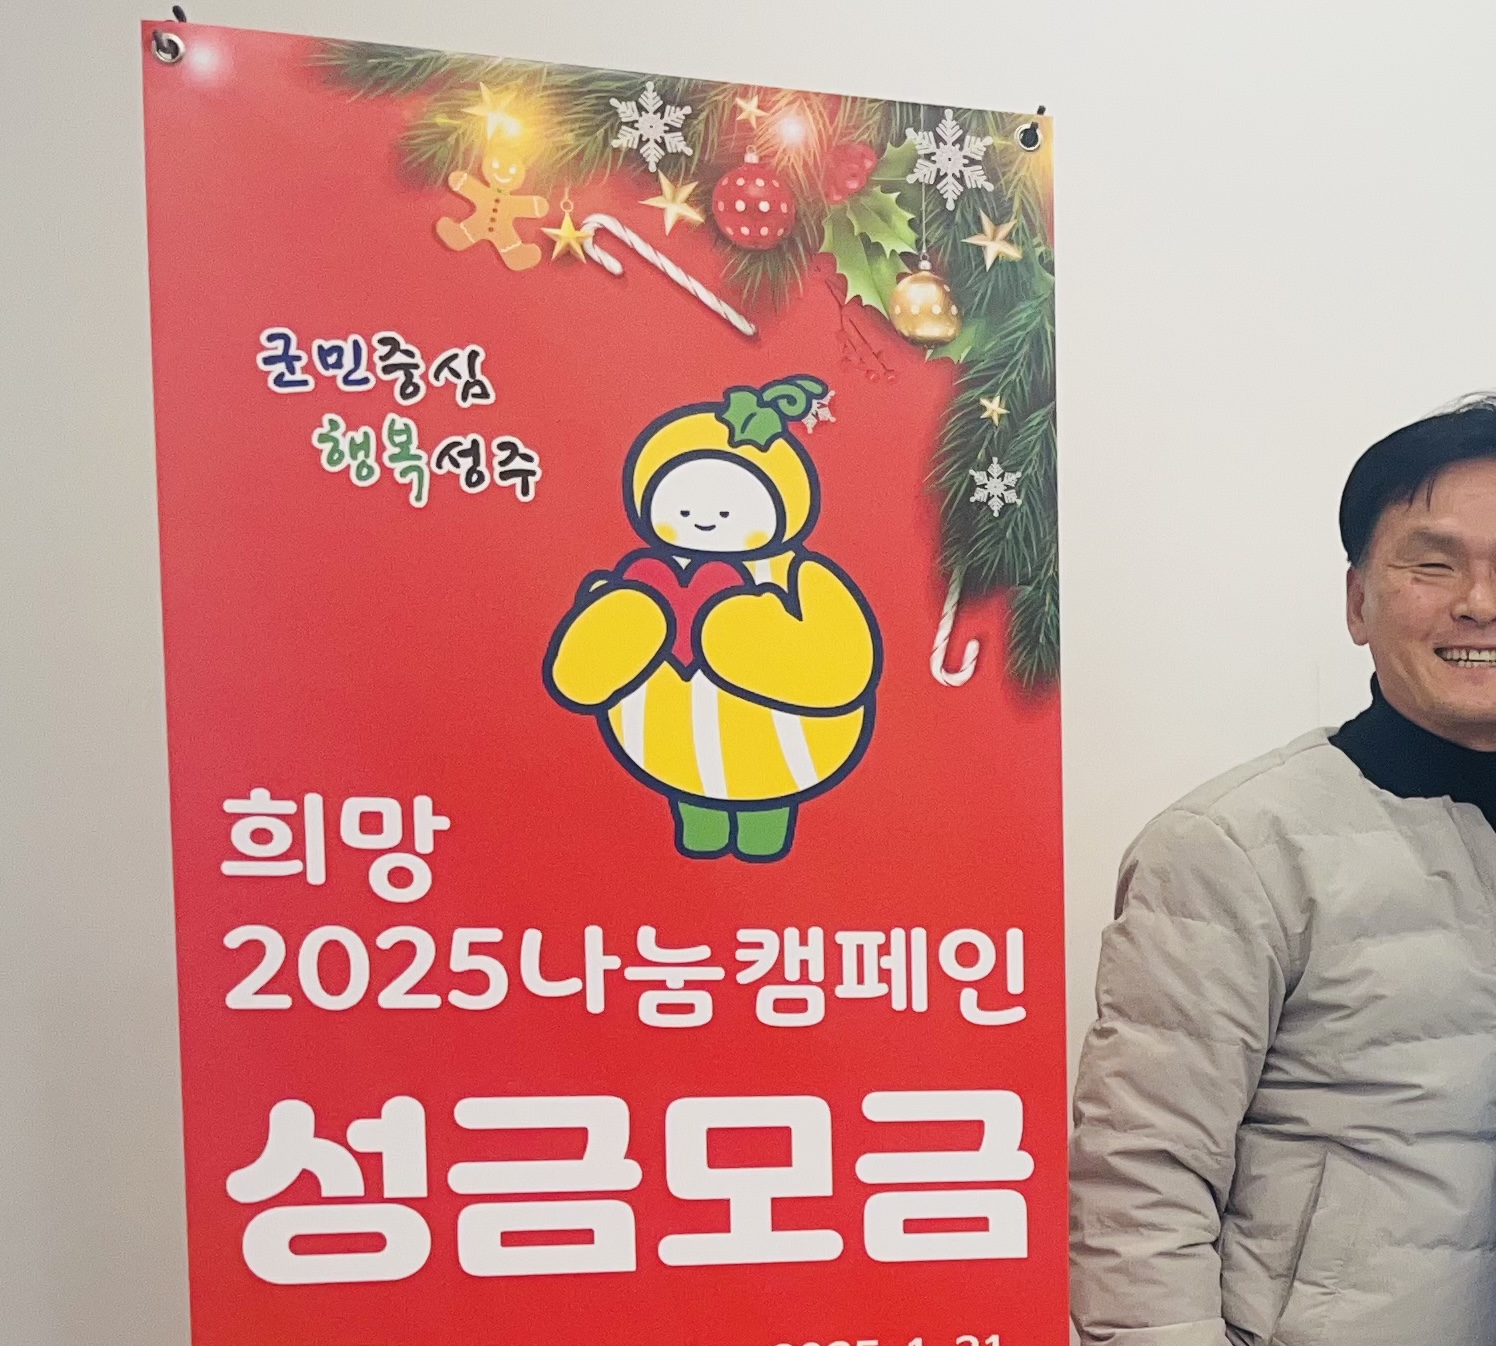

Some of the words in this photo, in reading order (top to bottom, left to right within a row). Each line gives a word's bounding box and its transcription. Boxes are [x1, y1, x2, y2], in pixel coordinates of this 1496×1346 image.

[258, 329, 494, 405] 군민중심
[315, 415, 541, 504] 행복성주
[220, 787, 451, 903] 희망
[226, 1089, 1035, 1285] 성금모금
